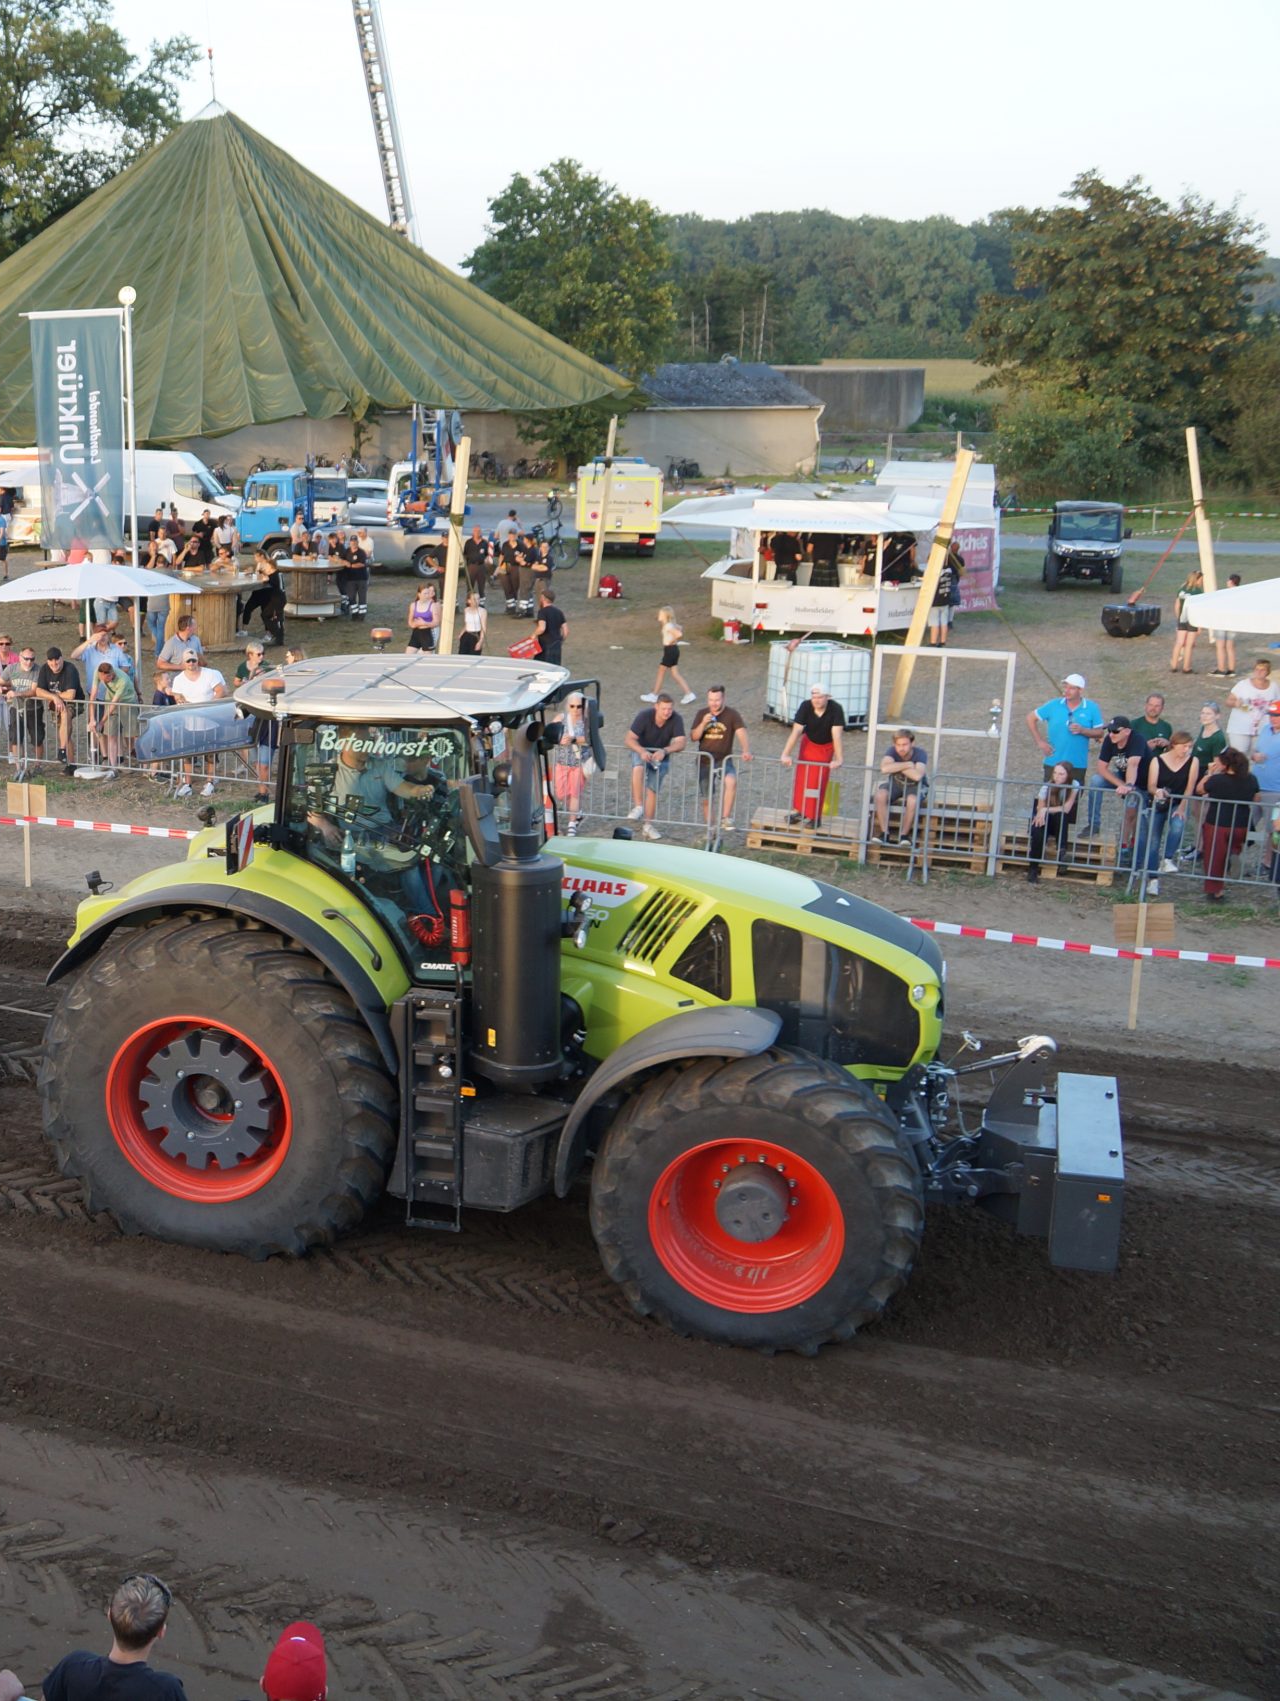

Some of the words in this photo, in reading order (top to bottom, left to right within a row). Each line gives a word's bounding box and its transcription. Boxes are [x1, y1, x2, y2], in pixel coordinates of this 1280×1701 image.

[320, 729, 428, 758] Batenhorst
[561, 876, 627, 896] CLAAS
[585, 908, 609, 921] 50
[420, 962, 456, 971] CMATIC
